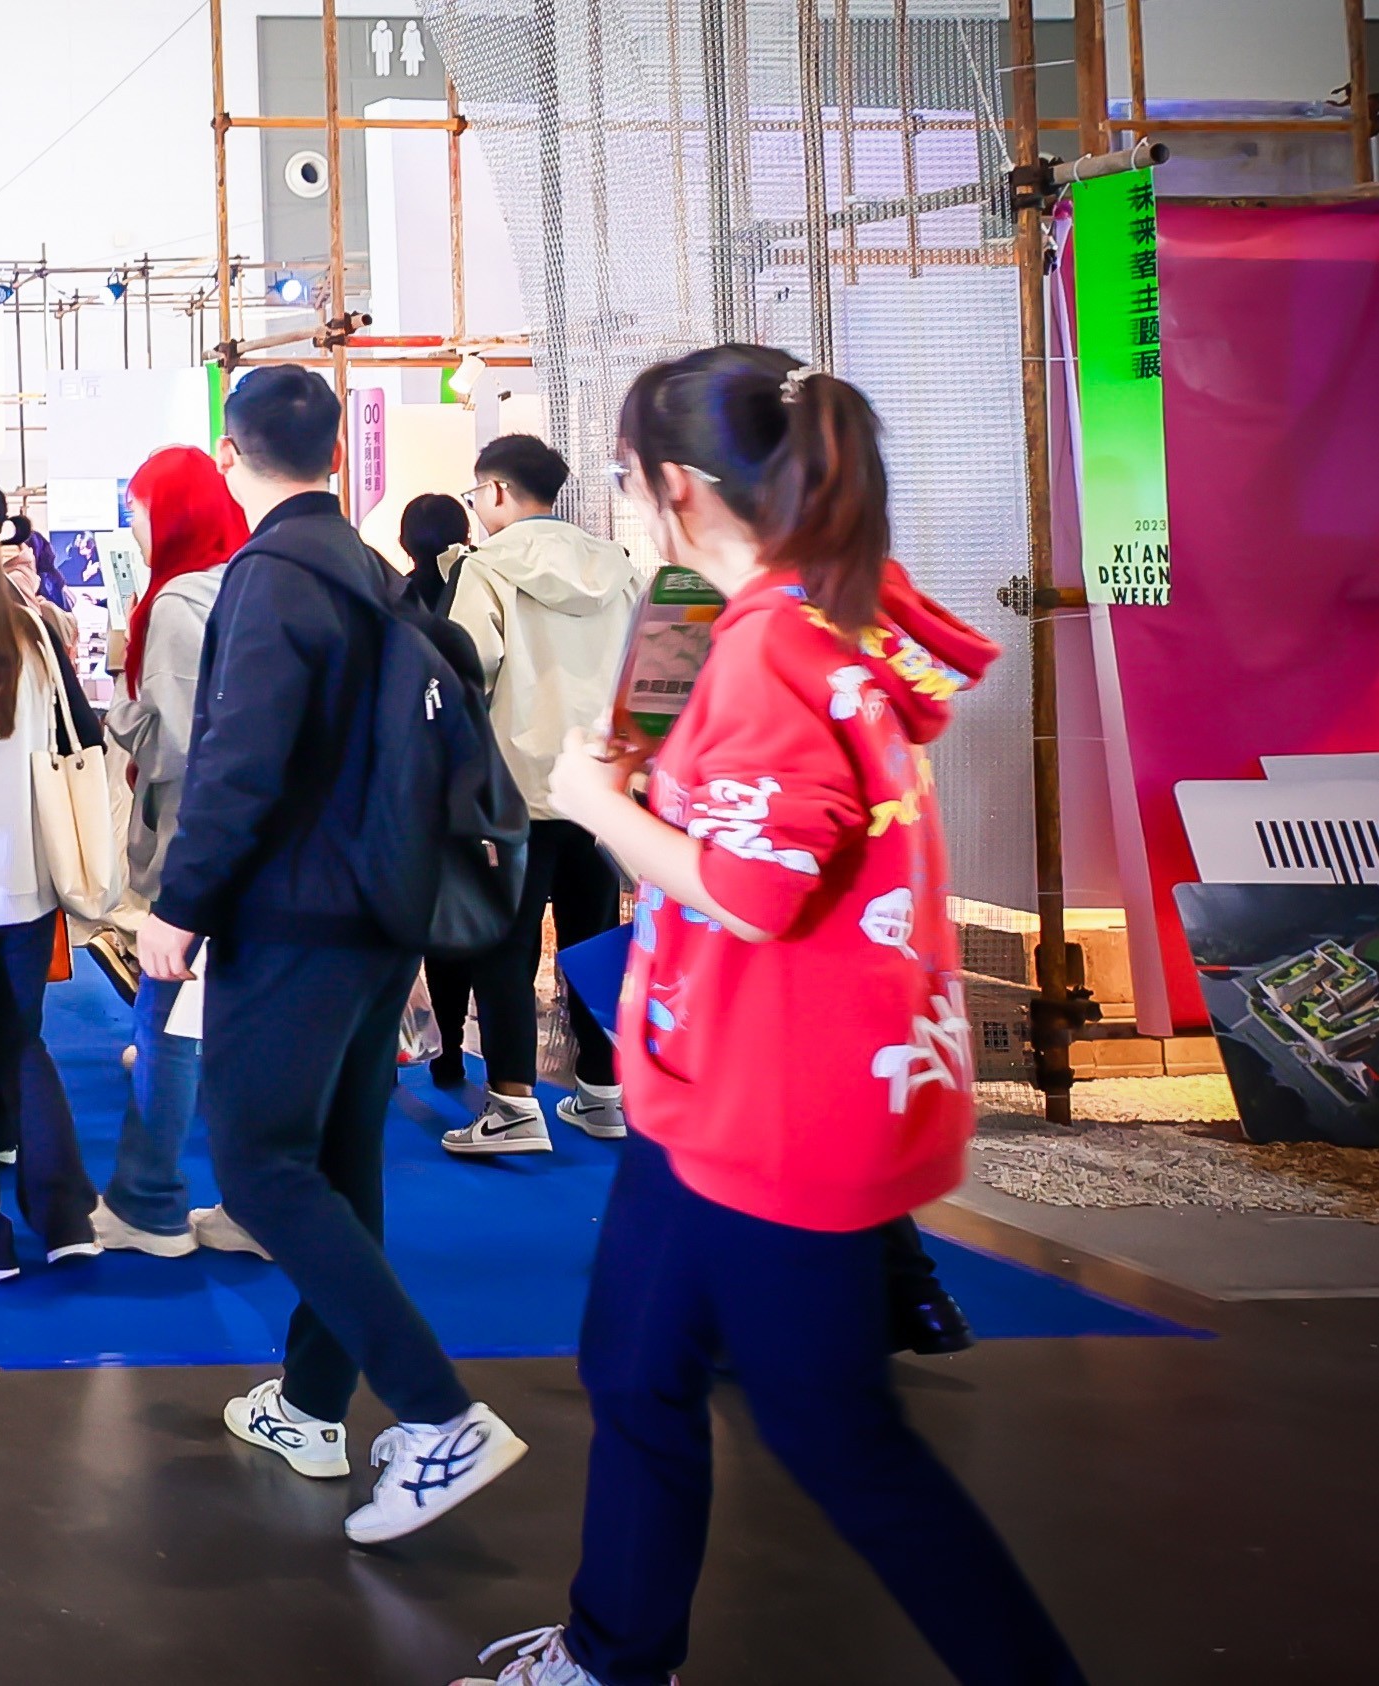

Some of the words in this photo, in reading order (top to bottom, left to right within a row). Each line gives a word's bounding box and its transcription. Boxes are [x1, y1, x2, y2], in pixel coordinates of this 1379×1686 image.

[1135, 519, 1167, 532] 2023
[1113, 541, 1169, 563] XI'AN
[1098, 565, 1171, 585] DESIGN
